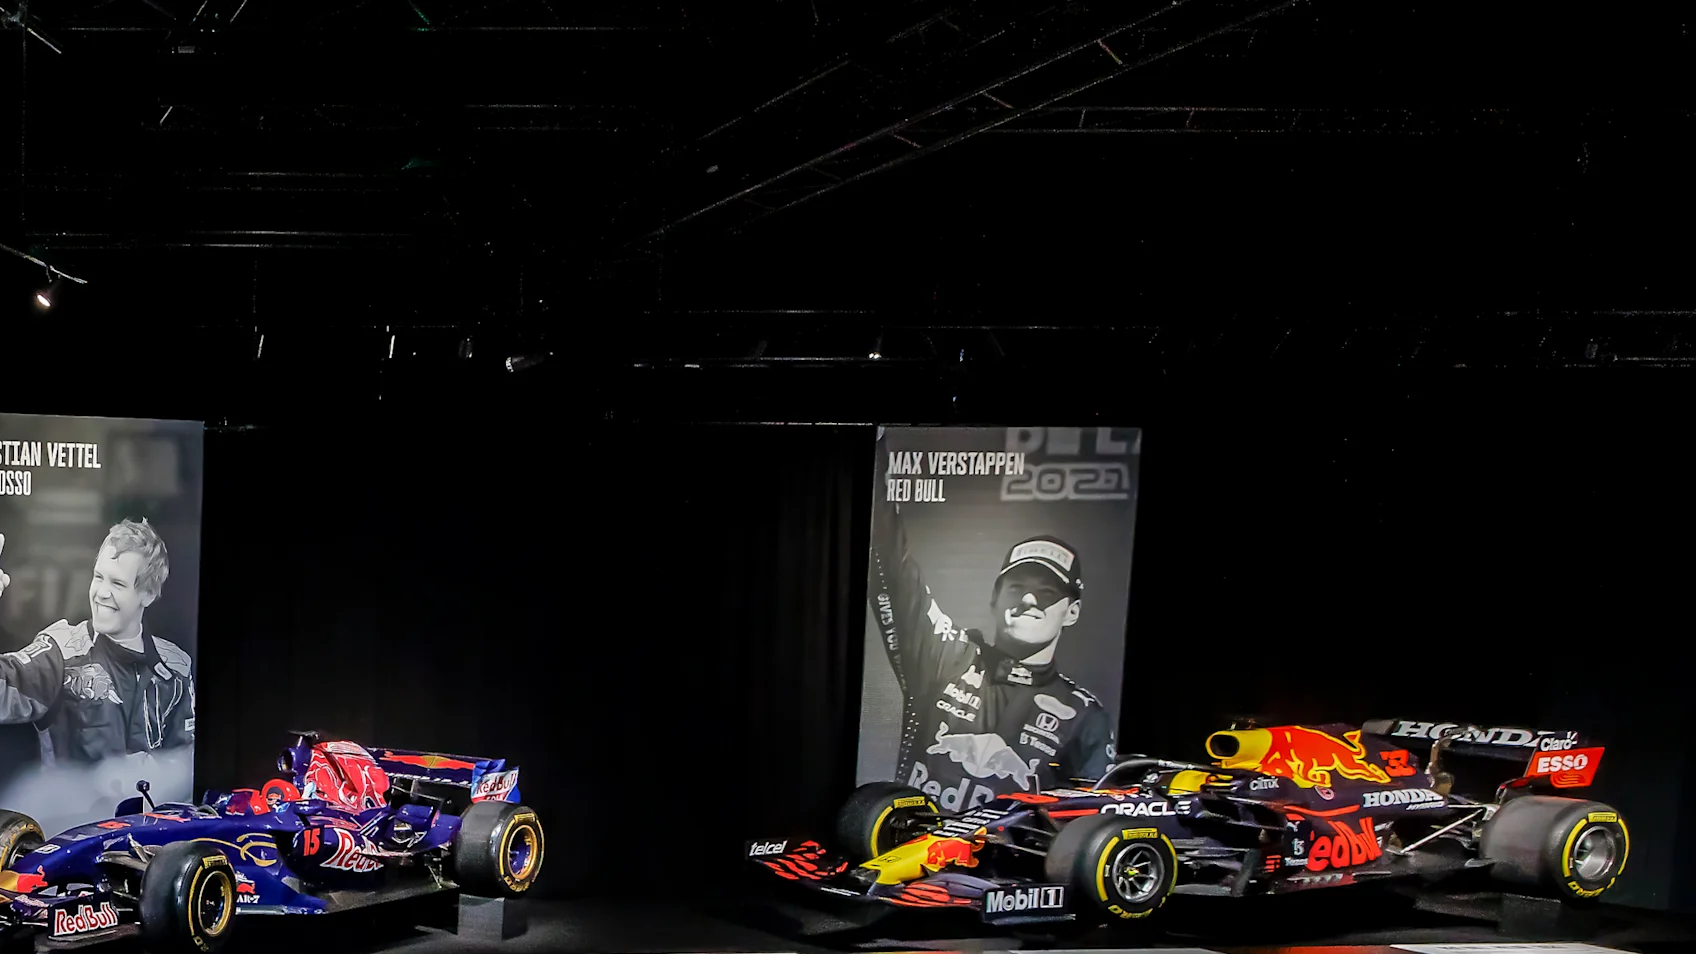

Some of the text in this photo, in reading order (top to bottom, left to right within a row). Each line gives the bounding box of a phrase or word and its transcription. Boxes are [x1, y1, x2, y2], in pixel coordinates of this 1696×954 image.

[47, 442, 102, 469] VETTEL
[888, 451, 1025, 476] MAX VERSTAPPEN
[887, 479, 946, 502] RED BULL
[1537, 754, 1588, 773] ESSO
[1362, 788, 1444, 808] HONDA
[304, 828, 321, 857] 15
[749, 840, 788, 857] telcel
[986, 888, 1040, 914] Mobil
